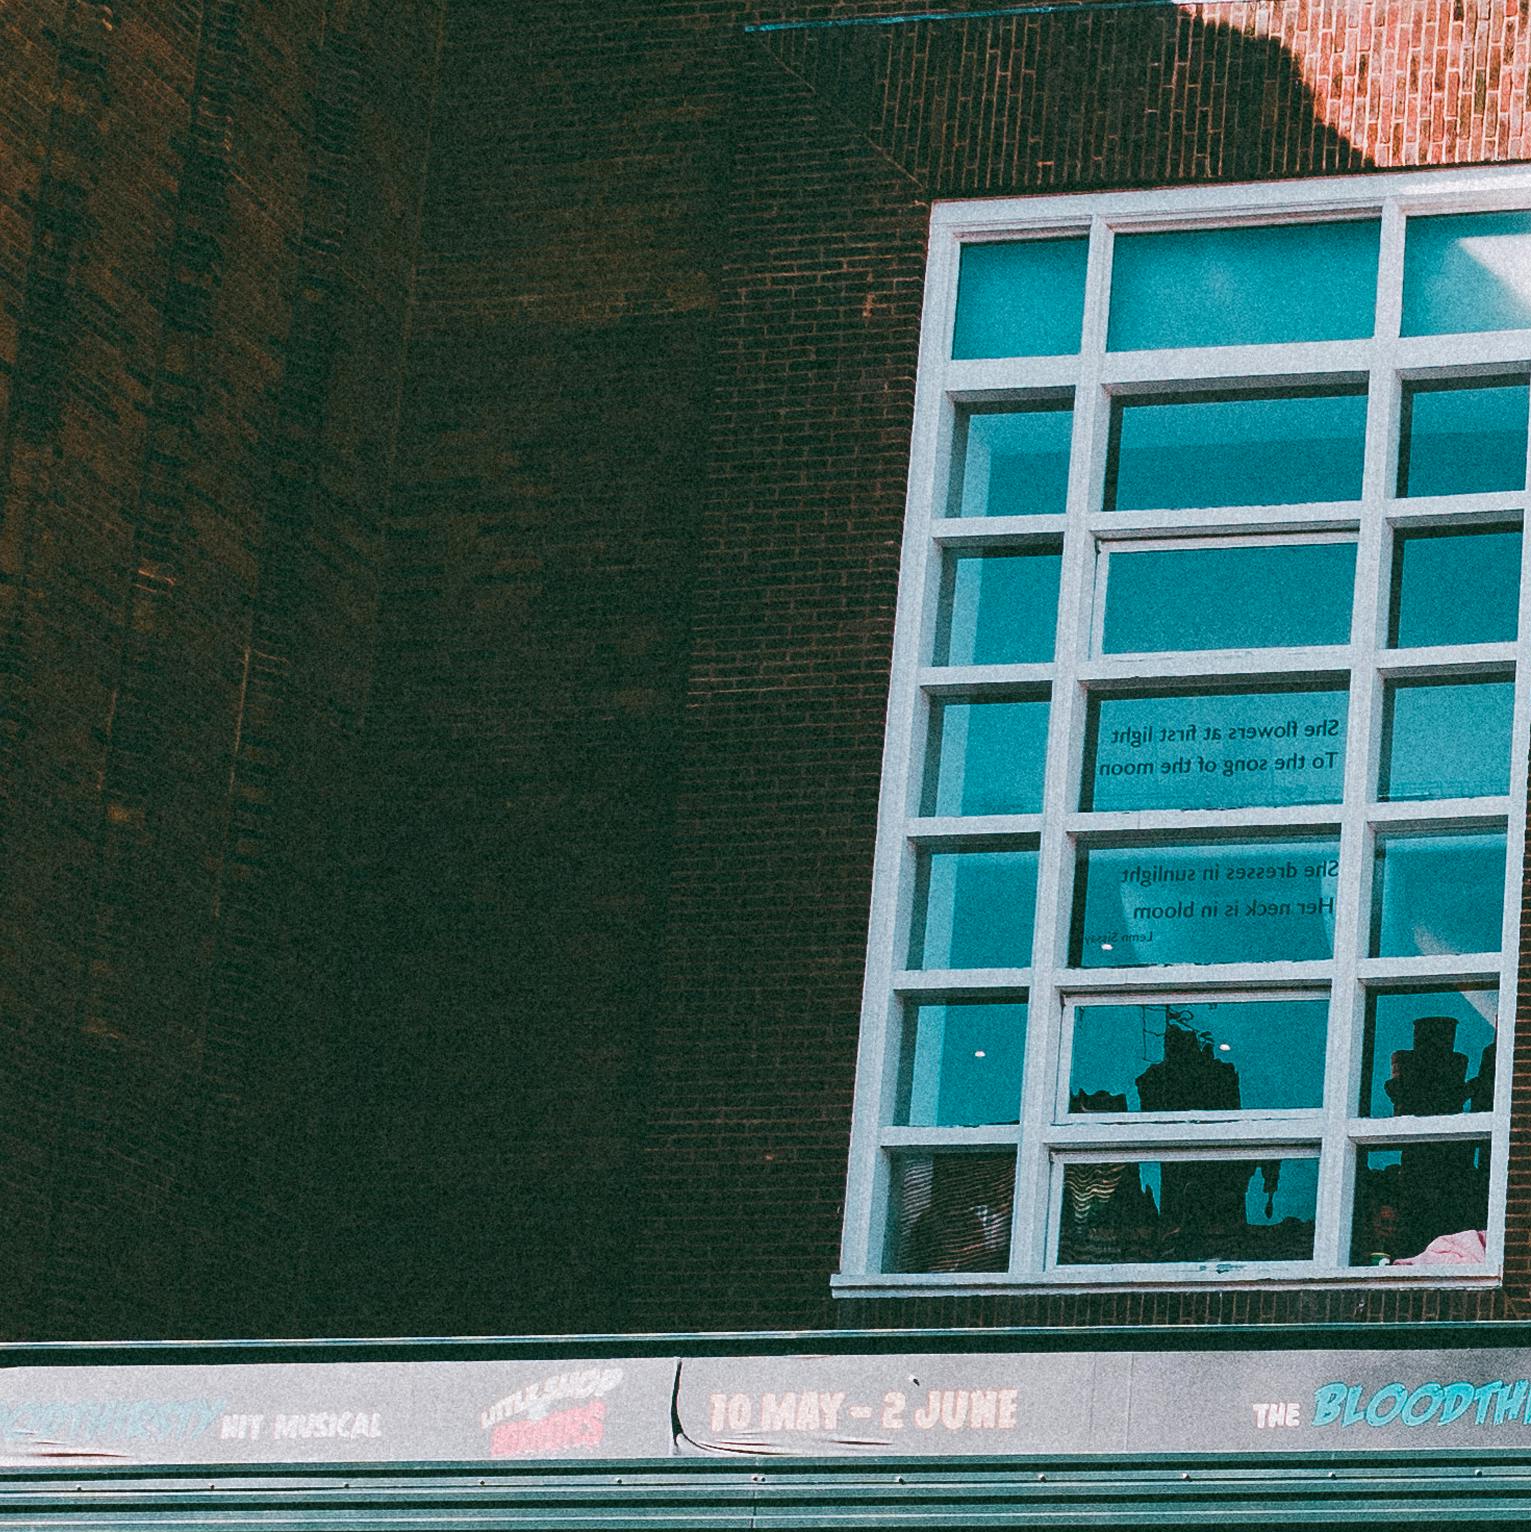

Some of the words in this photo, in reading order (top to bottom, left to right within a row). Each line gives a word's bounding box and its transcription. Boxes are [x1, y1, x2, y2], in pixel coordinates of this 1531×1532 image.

[710, 1393, 752, 1433] 10
[761, 1390, 840, 1432] MAY
[881, 1392, 905, 1429] 2
[914, 1387, 1018, 1430] JUNE
[1253, 1402, 1300, 1429] THE
[221, 1413, 266, 1439] HIT
[275, 1411, 382, 1439] MUSICAL
